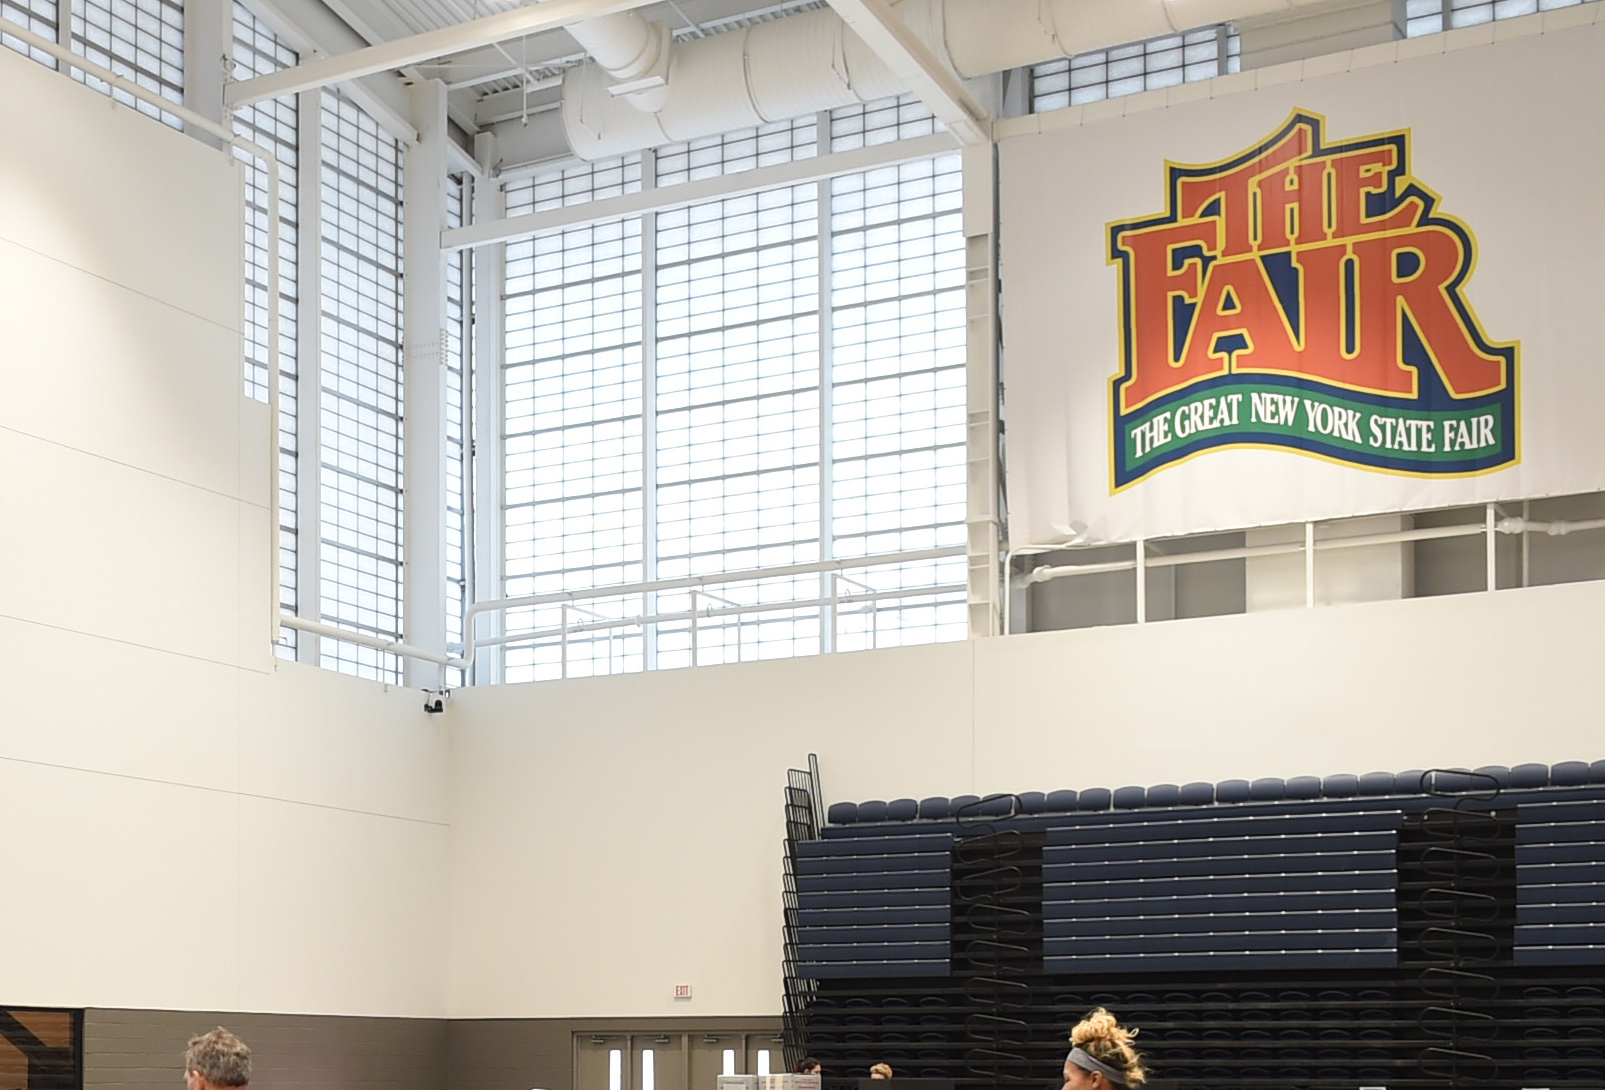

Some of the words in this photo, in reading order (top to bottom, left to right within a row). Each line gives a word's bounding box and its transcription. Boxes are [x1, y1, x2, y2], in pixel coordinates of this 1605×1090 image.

[1178, 123, 1421, 256] THE
[1119, 226, 1506, 414] FAIR
[1131, 411, 1173, 459] THE
[1174, 394, 1244, 438] GREAT
[1250, 392, 1299, 427] NEW
[1304, 398, 1363, 445] YORK
[1369, 415, 1436, 453] STATE
[1442, 414, 1496, 453] FAIR
[675, 985, 689, 996] EXIT
